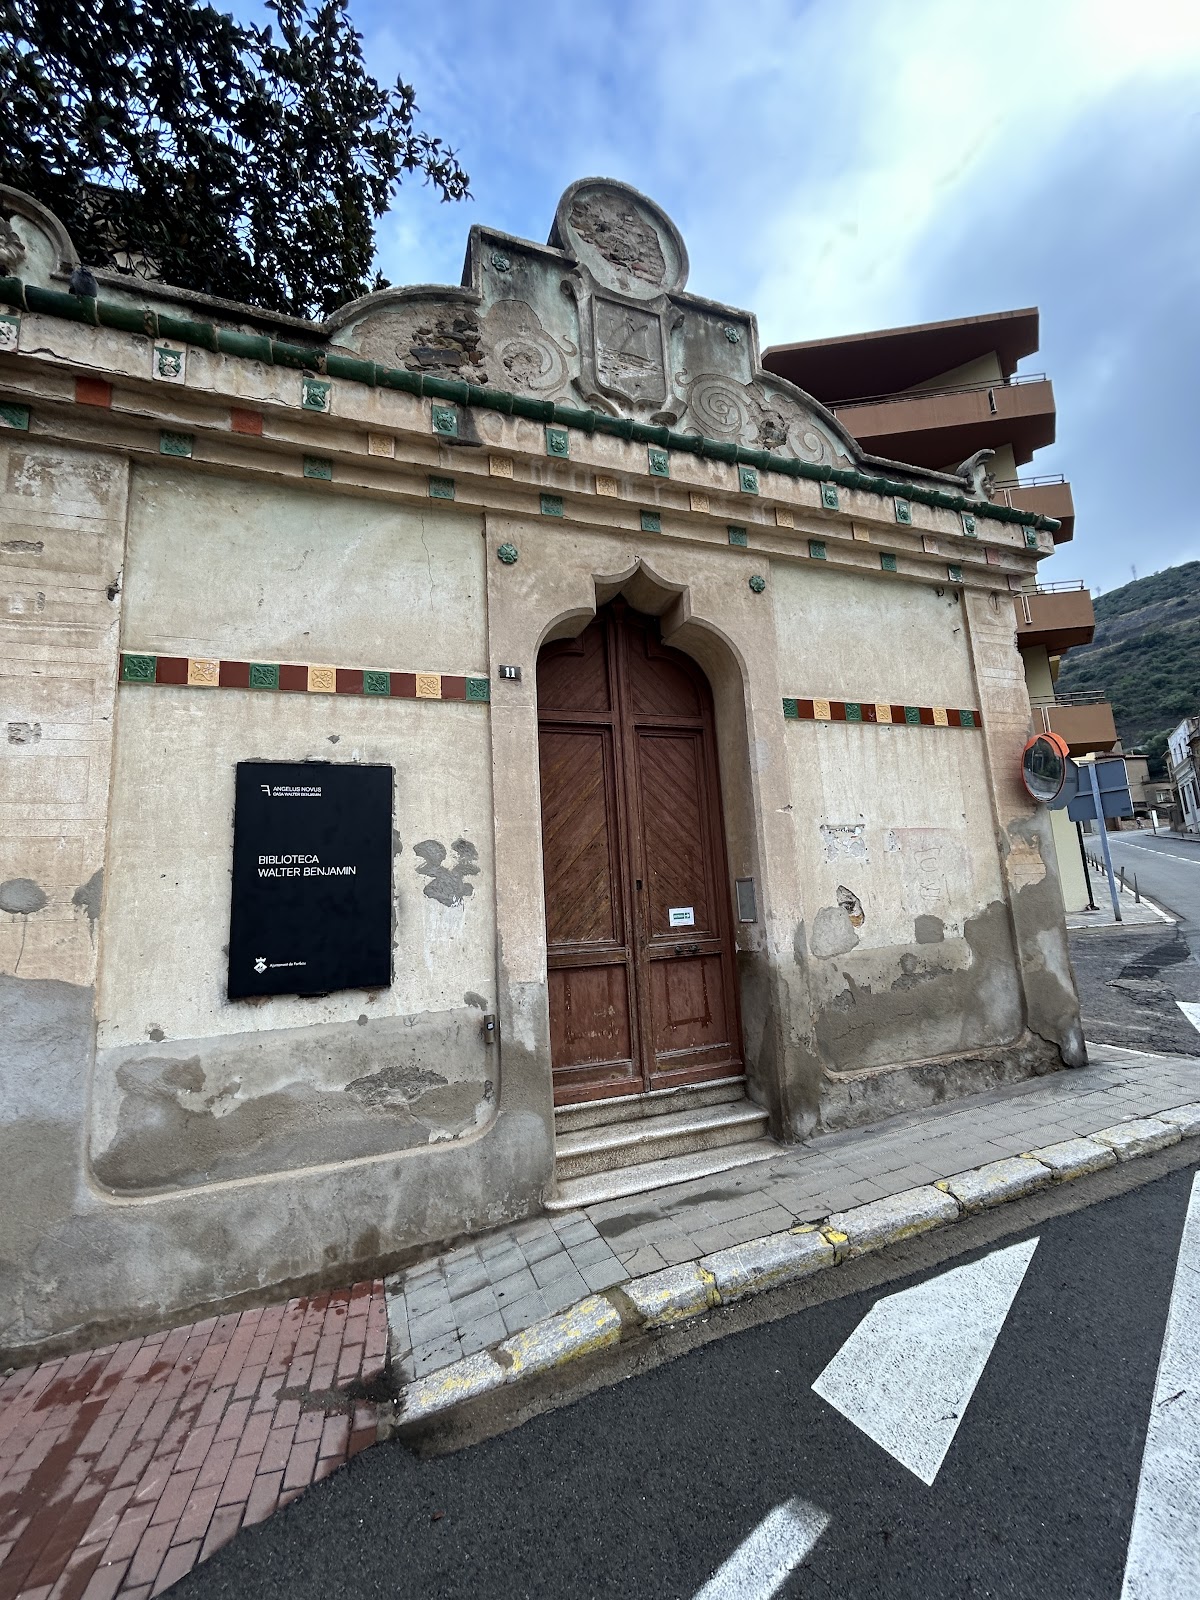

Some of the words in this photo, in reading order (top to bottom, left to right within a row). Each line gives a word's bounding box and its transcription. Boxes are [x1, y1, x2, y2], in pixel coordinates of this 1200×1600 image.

[505, 667, 516, 678] 11
[258, 854, 320, 865] BIBLIOTECA
[257, 867, 301, 878] WALTER
[303, 866, 357, 876] BENJAMIN
